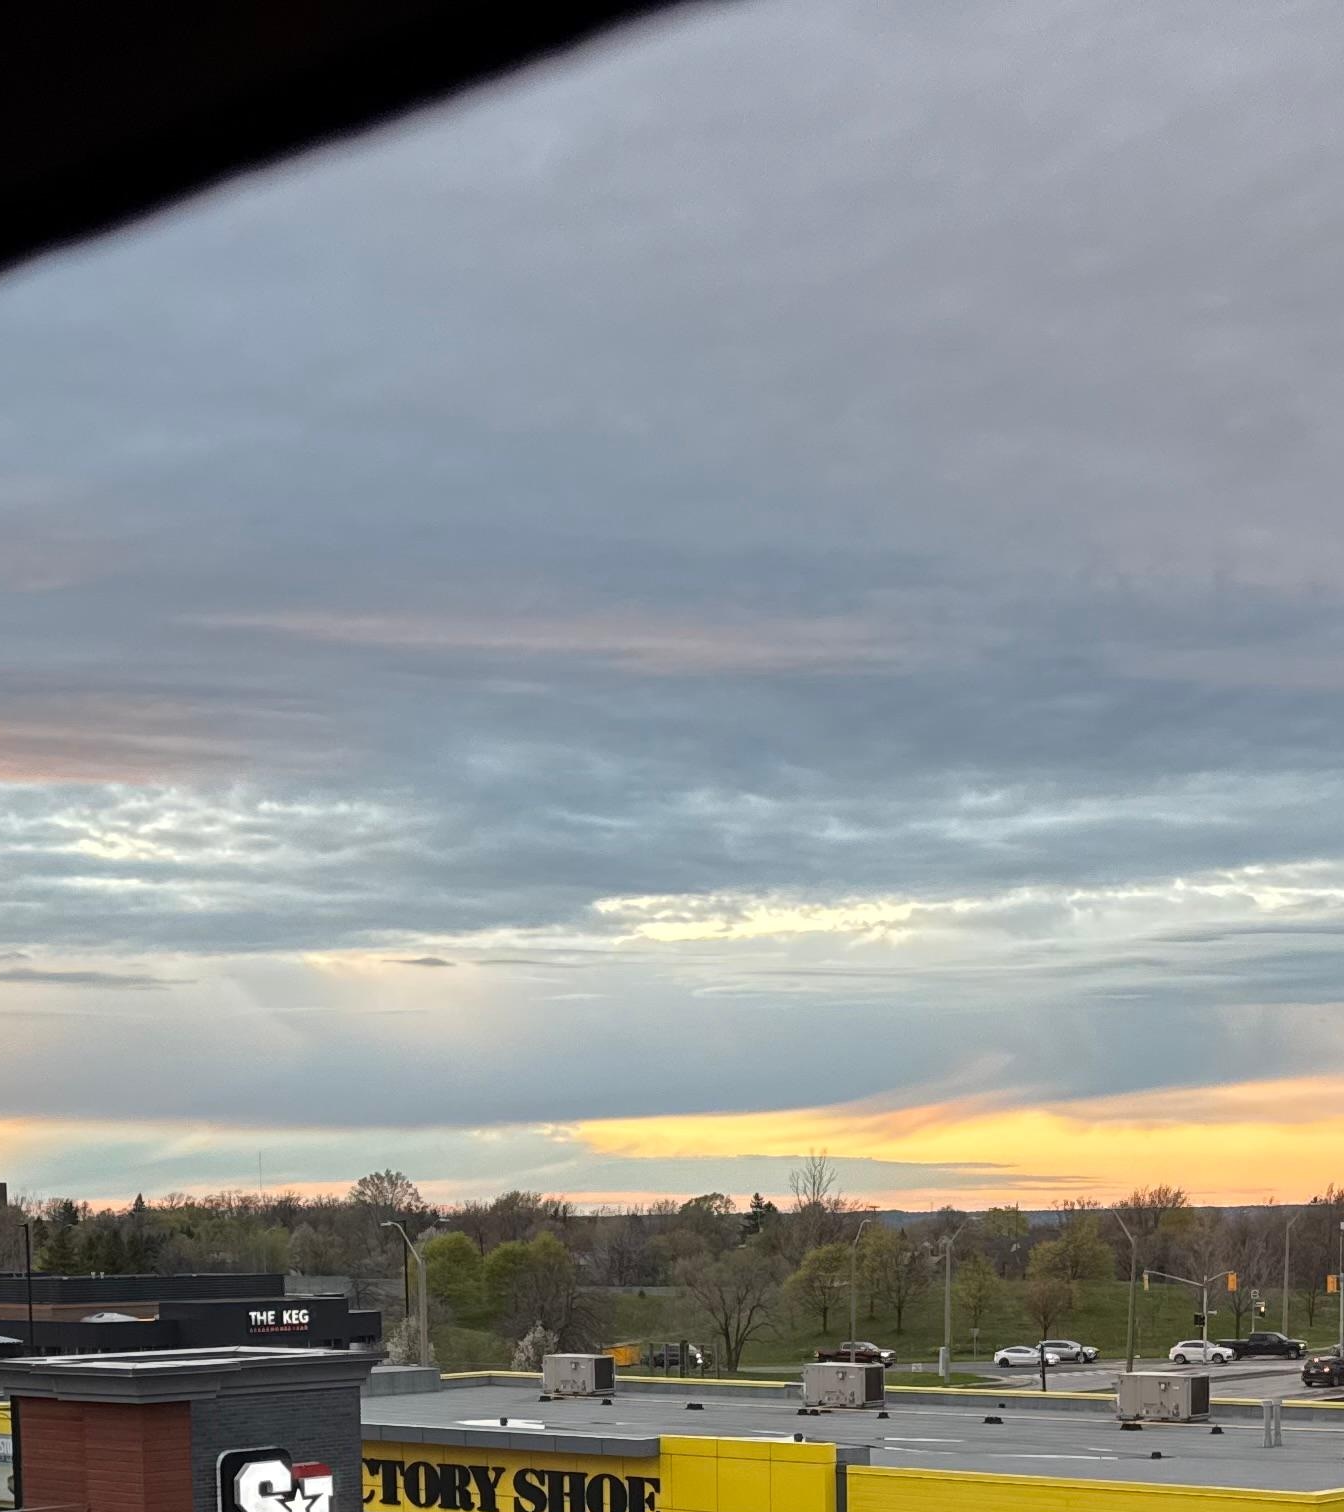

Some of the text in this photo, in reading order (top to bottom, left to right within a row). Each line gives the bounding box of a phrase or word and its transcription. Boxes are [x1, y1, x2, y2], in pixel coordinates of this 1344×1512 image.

[249, 1308, 310, 1326] THE KEG
[361, 1458, 506, 1512] CTORY
